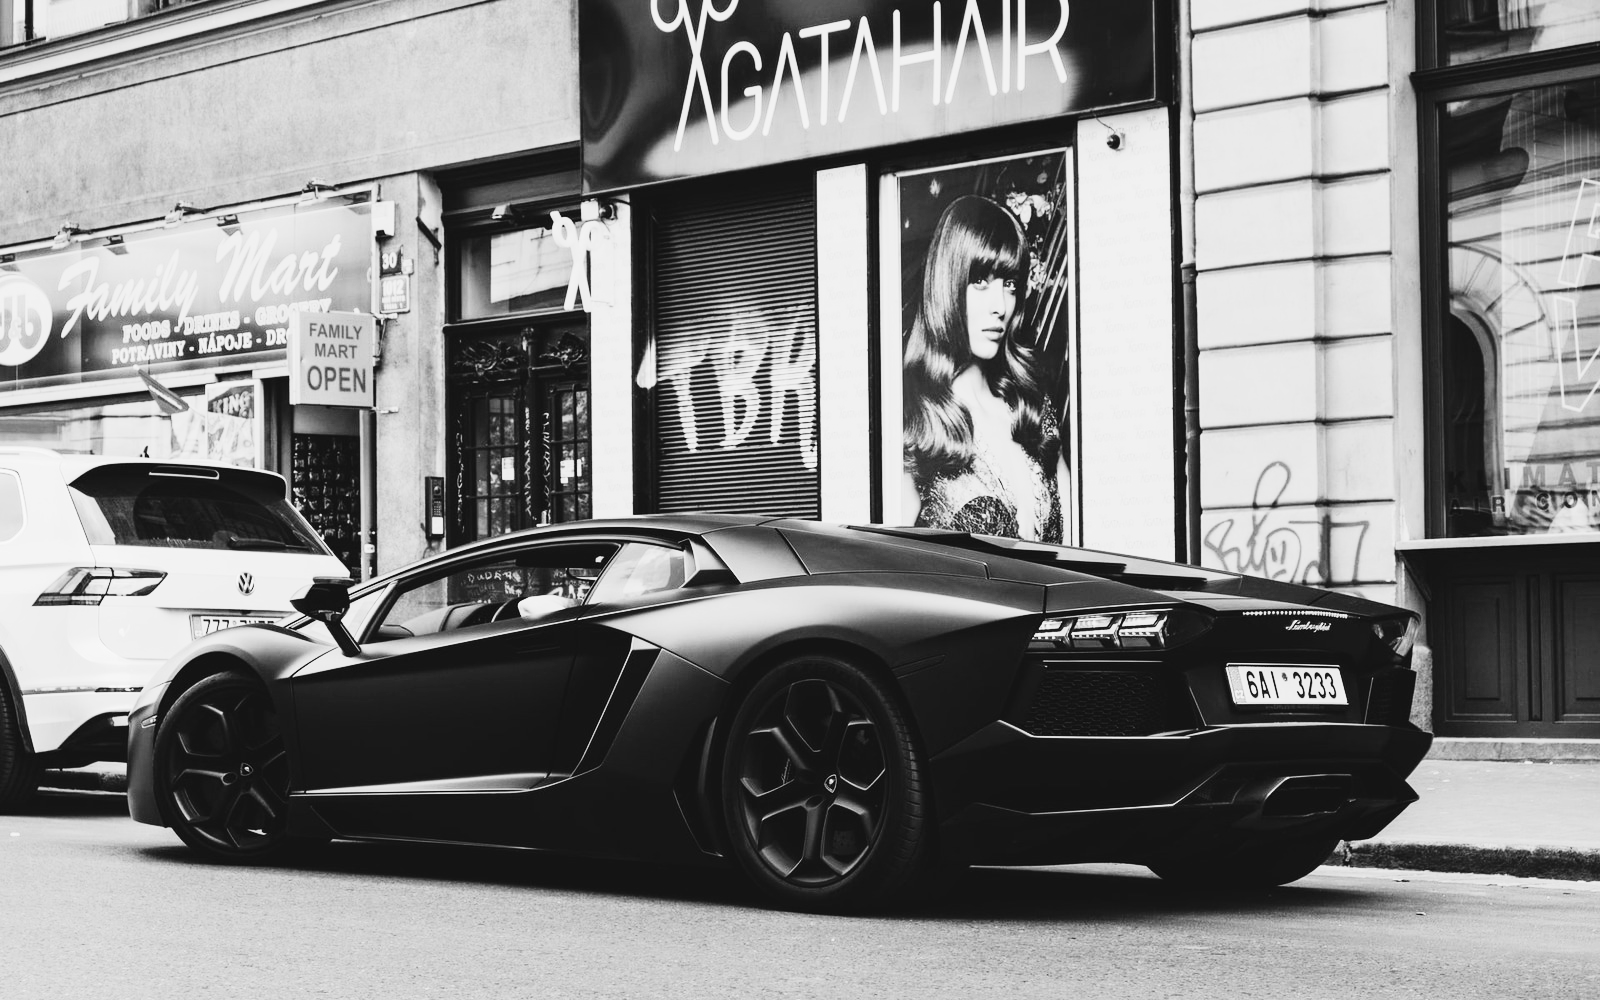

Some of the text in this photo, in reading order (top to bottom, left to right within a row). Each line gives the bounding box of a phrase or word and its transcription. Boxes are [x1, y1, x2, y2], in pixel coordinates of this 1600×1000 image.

[382, 252, 397, 270] 30
[57, 228, 342, 339] Family Mart
[122, 320, 171, 343] FOODS
[184, 310, 241, 335] DRINKS
[309, 322, 362, 340] FAMILY
[111, 340, 186, 365] POTRAVINY
[198, 332, 252, 354] NÁPOJE
[315, 343, 357, 359] MART
[307, 365, 366, 393] OPEN
[1292, 671, 1337, 699] 3233
